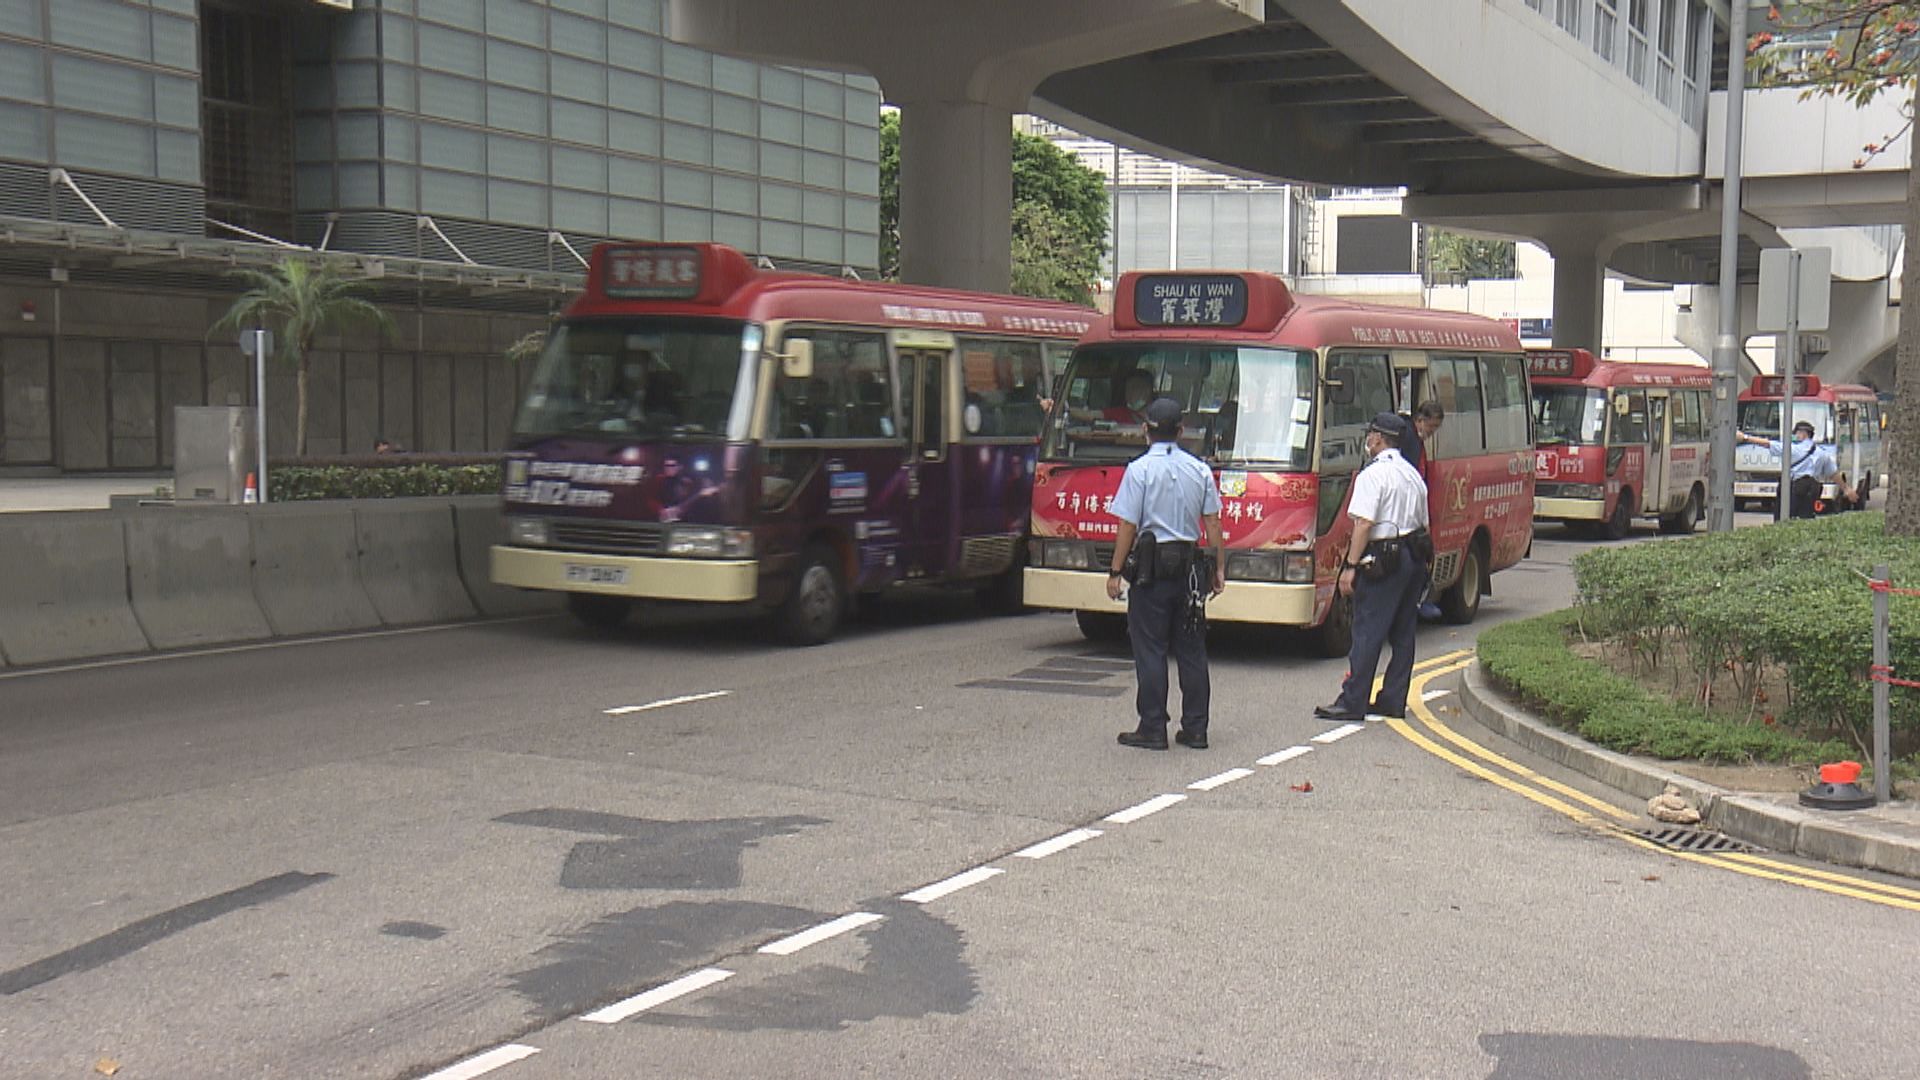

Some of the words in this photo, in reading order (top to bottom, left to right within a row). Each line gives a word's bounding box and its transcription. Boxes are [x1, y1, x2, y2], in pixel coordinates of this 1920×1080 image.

[1154, 284, 1184, 297] SHAU
[1189, 284, 1201, 296] KI
[1207, 284, 1233, 296] WAN
[1161, 298, 1224, 323] 筲箕灣
[1218, 500, 1264, 525] 輝煌
